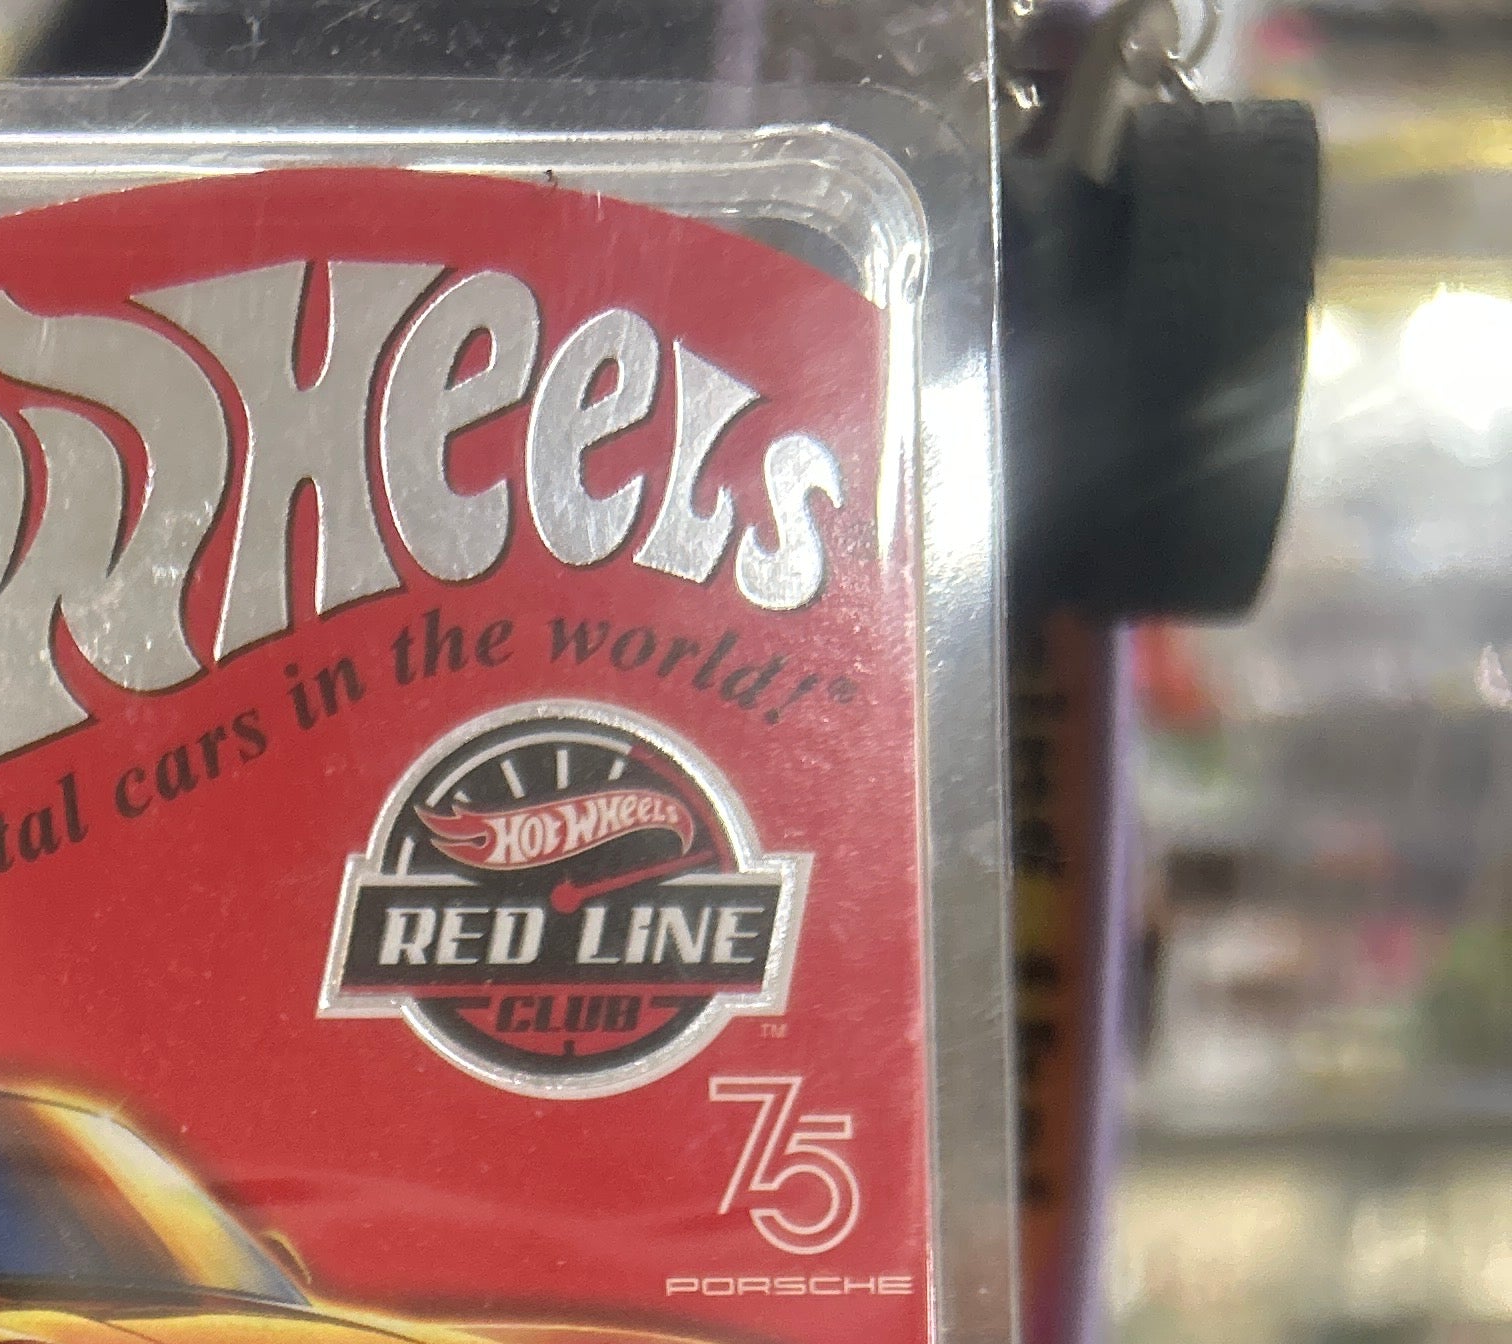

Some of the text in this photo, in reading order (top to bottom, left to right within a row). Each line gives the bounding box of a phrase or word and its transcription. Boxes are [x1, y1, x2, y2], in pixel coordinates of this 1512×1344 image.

[113, 705, 270, 822] cars
[288, 652, 366, 732] in
[390, 606, 516, 686] the
[378, 905, 545, 966] RED
[494, 994, 643, 1034] CLUB
[707, 1075, 861, 1256] 75
[665, 1274, 914, 1297] PORSCHE
